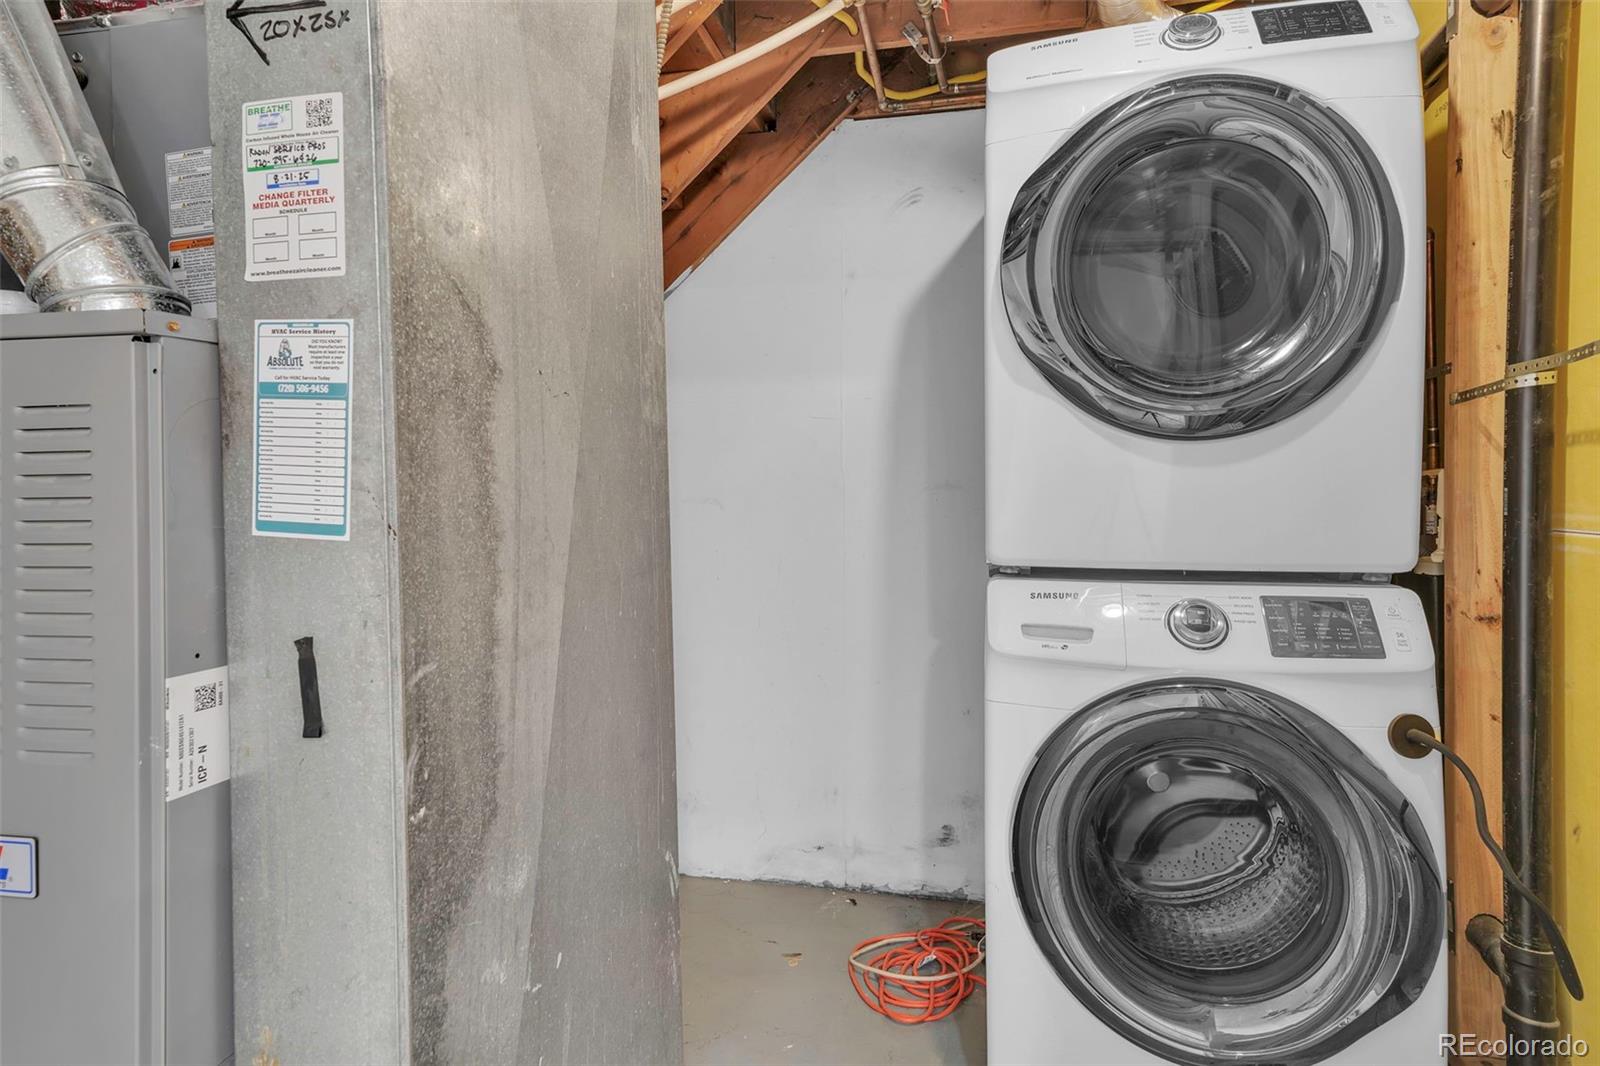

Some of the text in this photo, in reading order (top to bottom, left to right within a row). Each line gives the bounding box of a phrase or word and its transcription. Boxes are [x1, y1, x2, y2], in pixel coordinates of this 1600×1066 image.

[247, 103, 290, 116] BREATHE
[258, 188, 328, 201] CHANGE FILTER
[252, 196, 335, 210] MEDIA QUARTERLY
[266, 355, 304, 367] ABSOLUTE
[278, 384, 329, 393] (720) 506-9456
[1030, 592, 1079, 600] SAMSUNG
[198, 745, 207, 754] N
[198, 765, 207, 783] ICP
